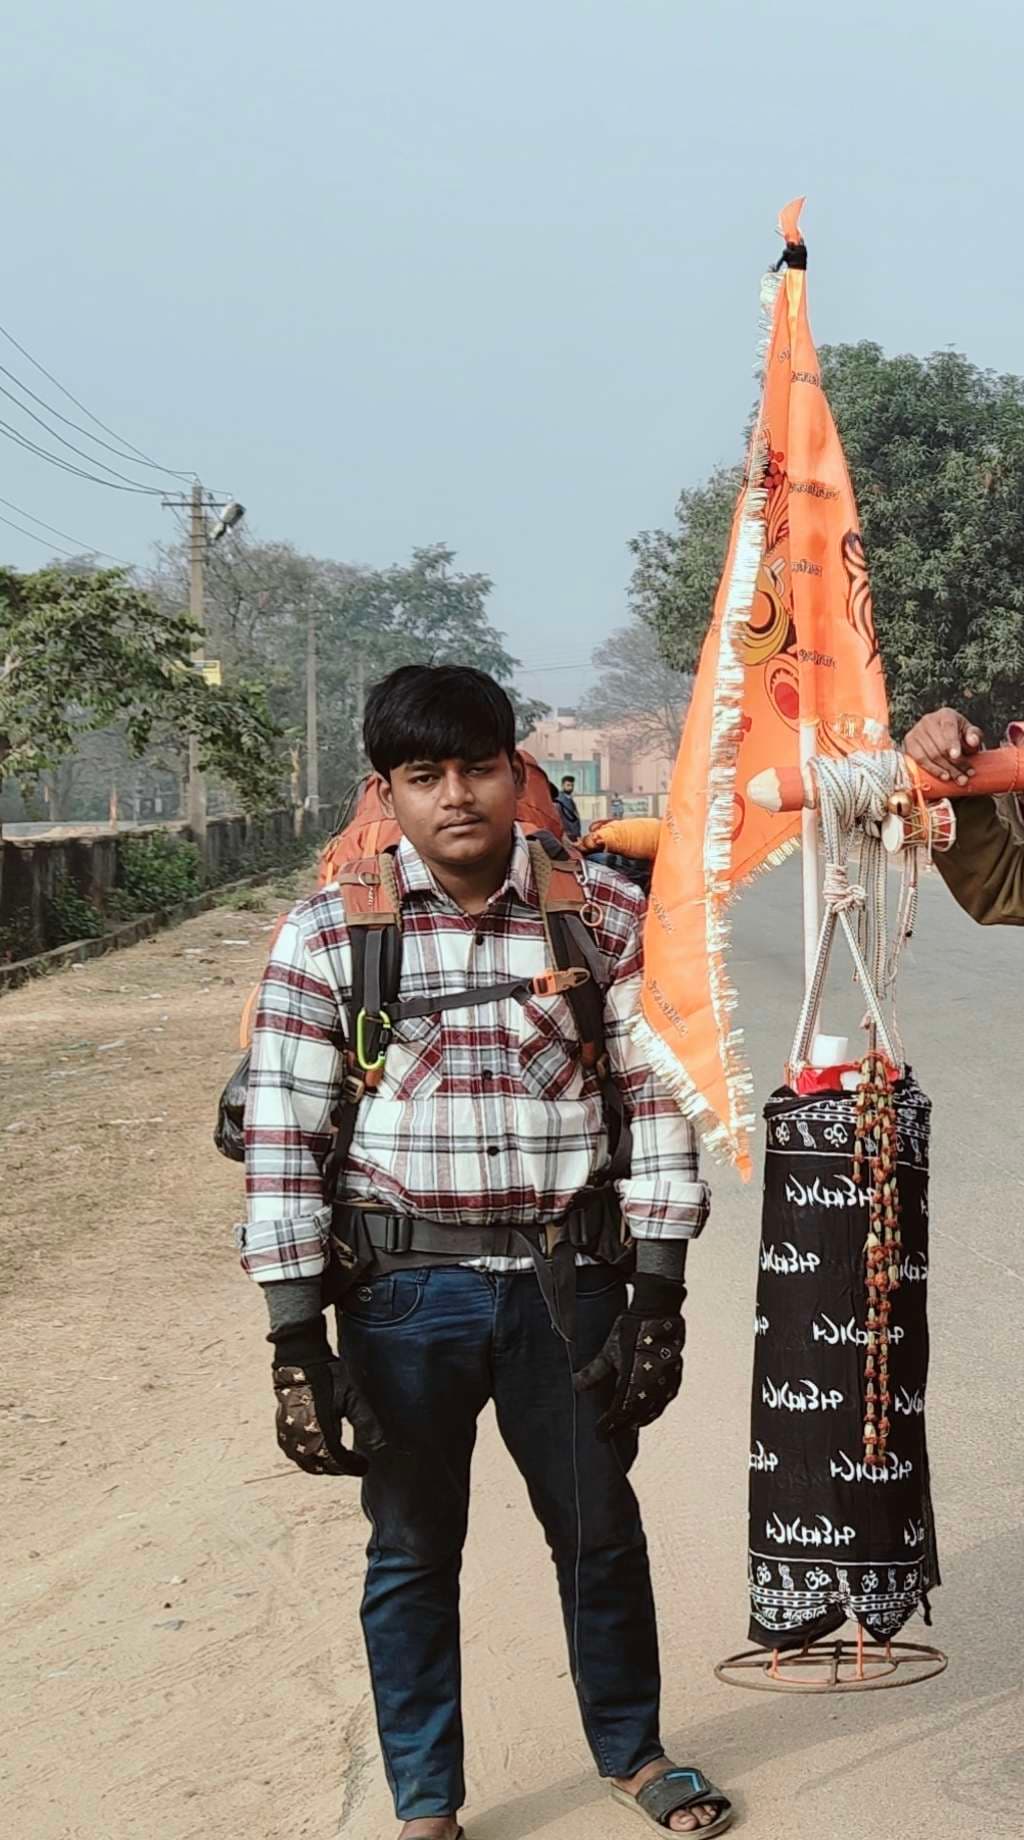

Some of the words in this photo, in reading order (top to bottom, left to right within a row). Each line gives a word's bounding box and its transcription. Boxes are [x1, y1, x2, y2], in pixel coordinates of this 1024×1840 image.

[762, 1376, 844, 1413] महाकाल
[830, 1450, 913, 1483] महाकाल
[766, 1512, 857, 1548] महाकाल
